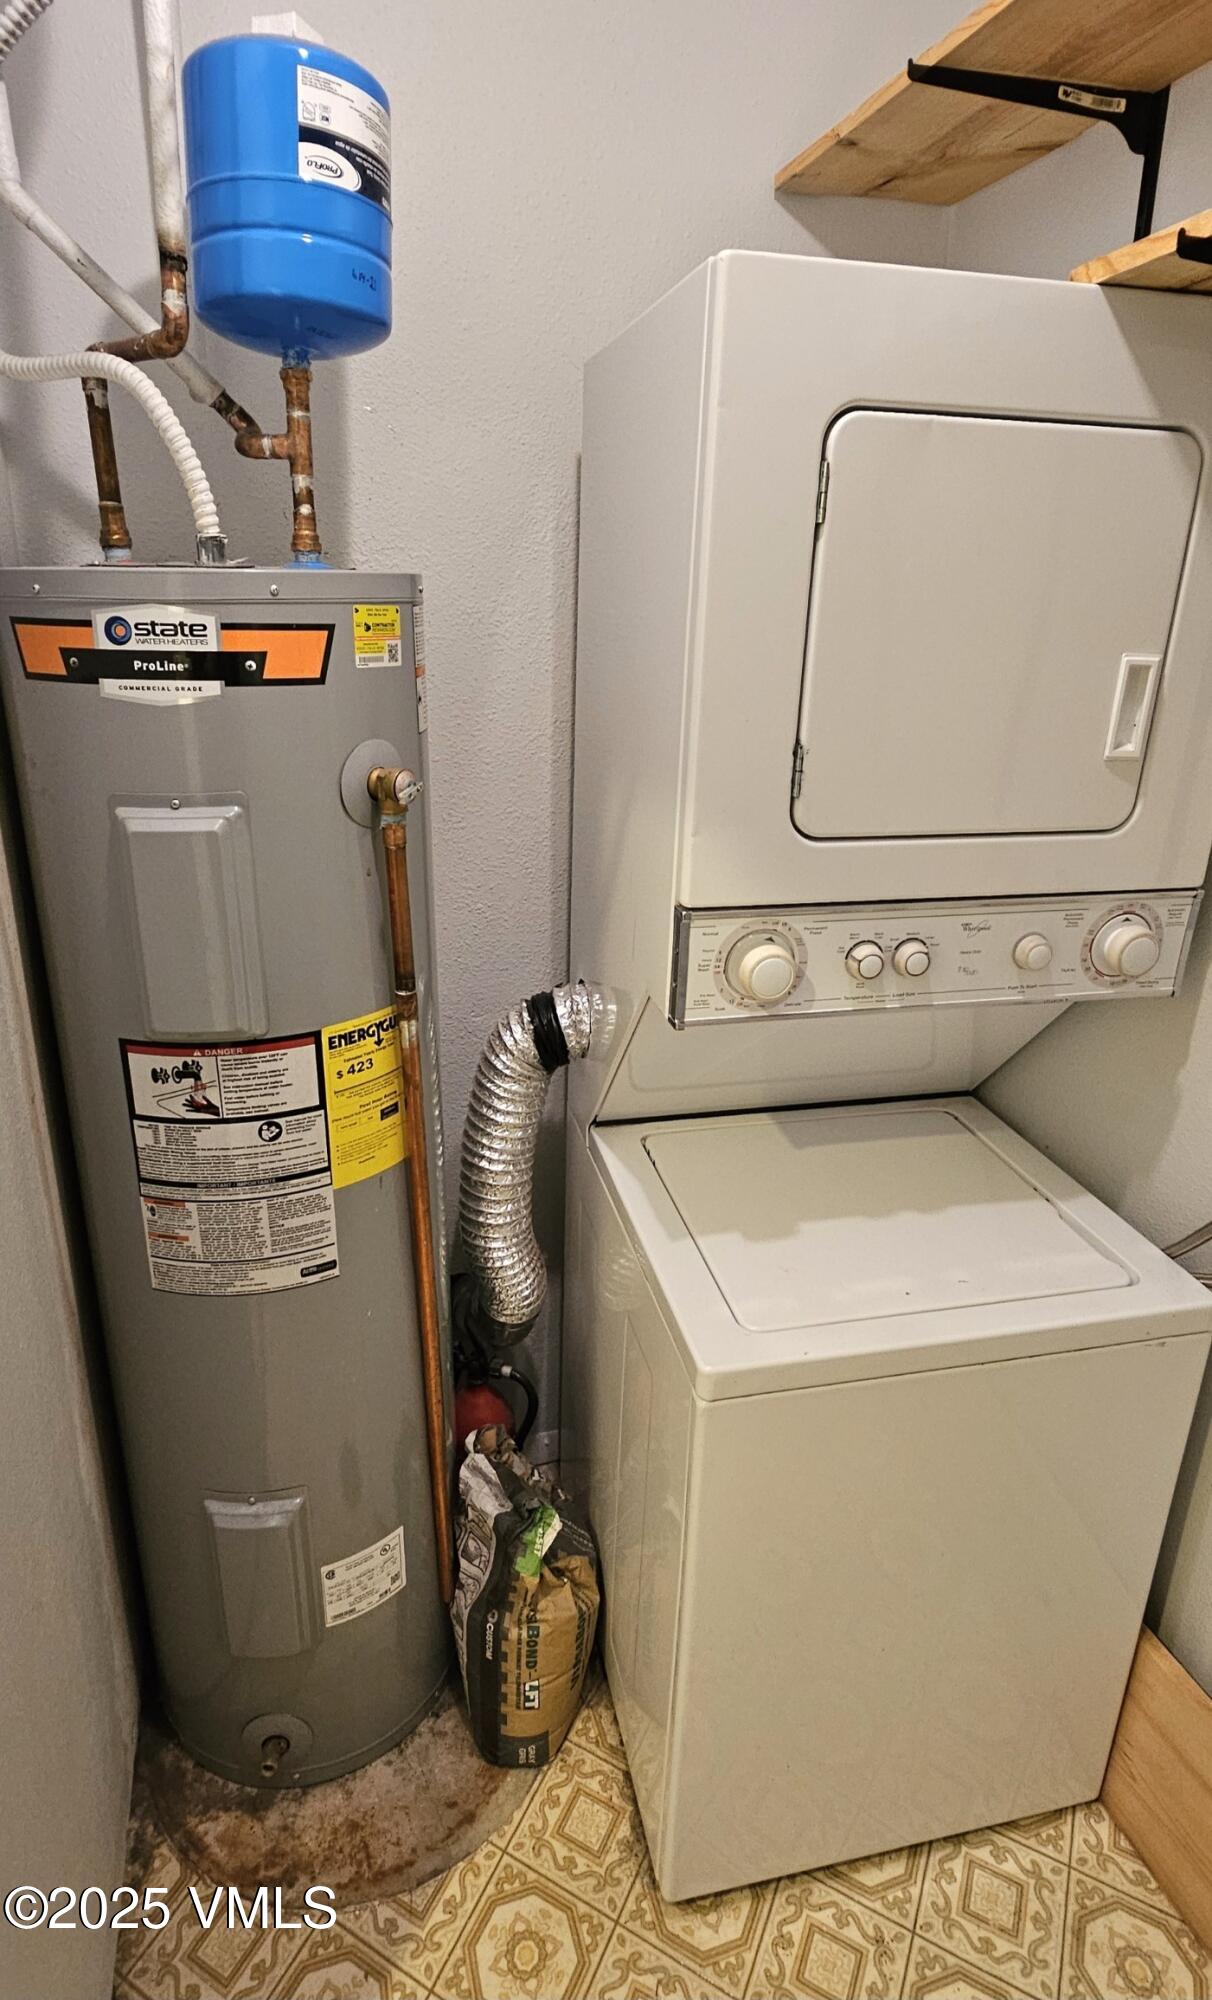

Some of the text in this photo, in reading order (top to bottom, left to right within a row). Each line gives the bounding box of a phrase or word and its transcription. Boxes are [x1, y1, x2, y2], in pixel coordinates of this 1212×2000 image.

[133, 620, 208, 638] state
[134, 637, 209, 646] WATER HEATERS
[118, 684, 172, 692] COMMERCIAL
[327, 1014, 397, 1051] ENERGYGU
[204, 1047, 244, 1056] DANGER
[336, 1057, 374, 1080] $ 423
[485, 1623, 494, 1660] CUSTOM
[524, 1680, 540, 1710] LFT
[527, 1744, 537, 1764] GRAY
